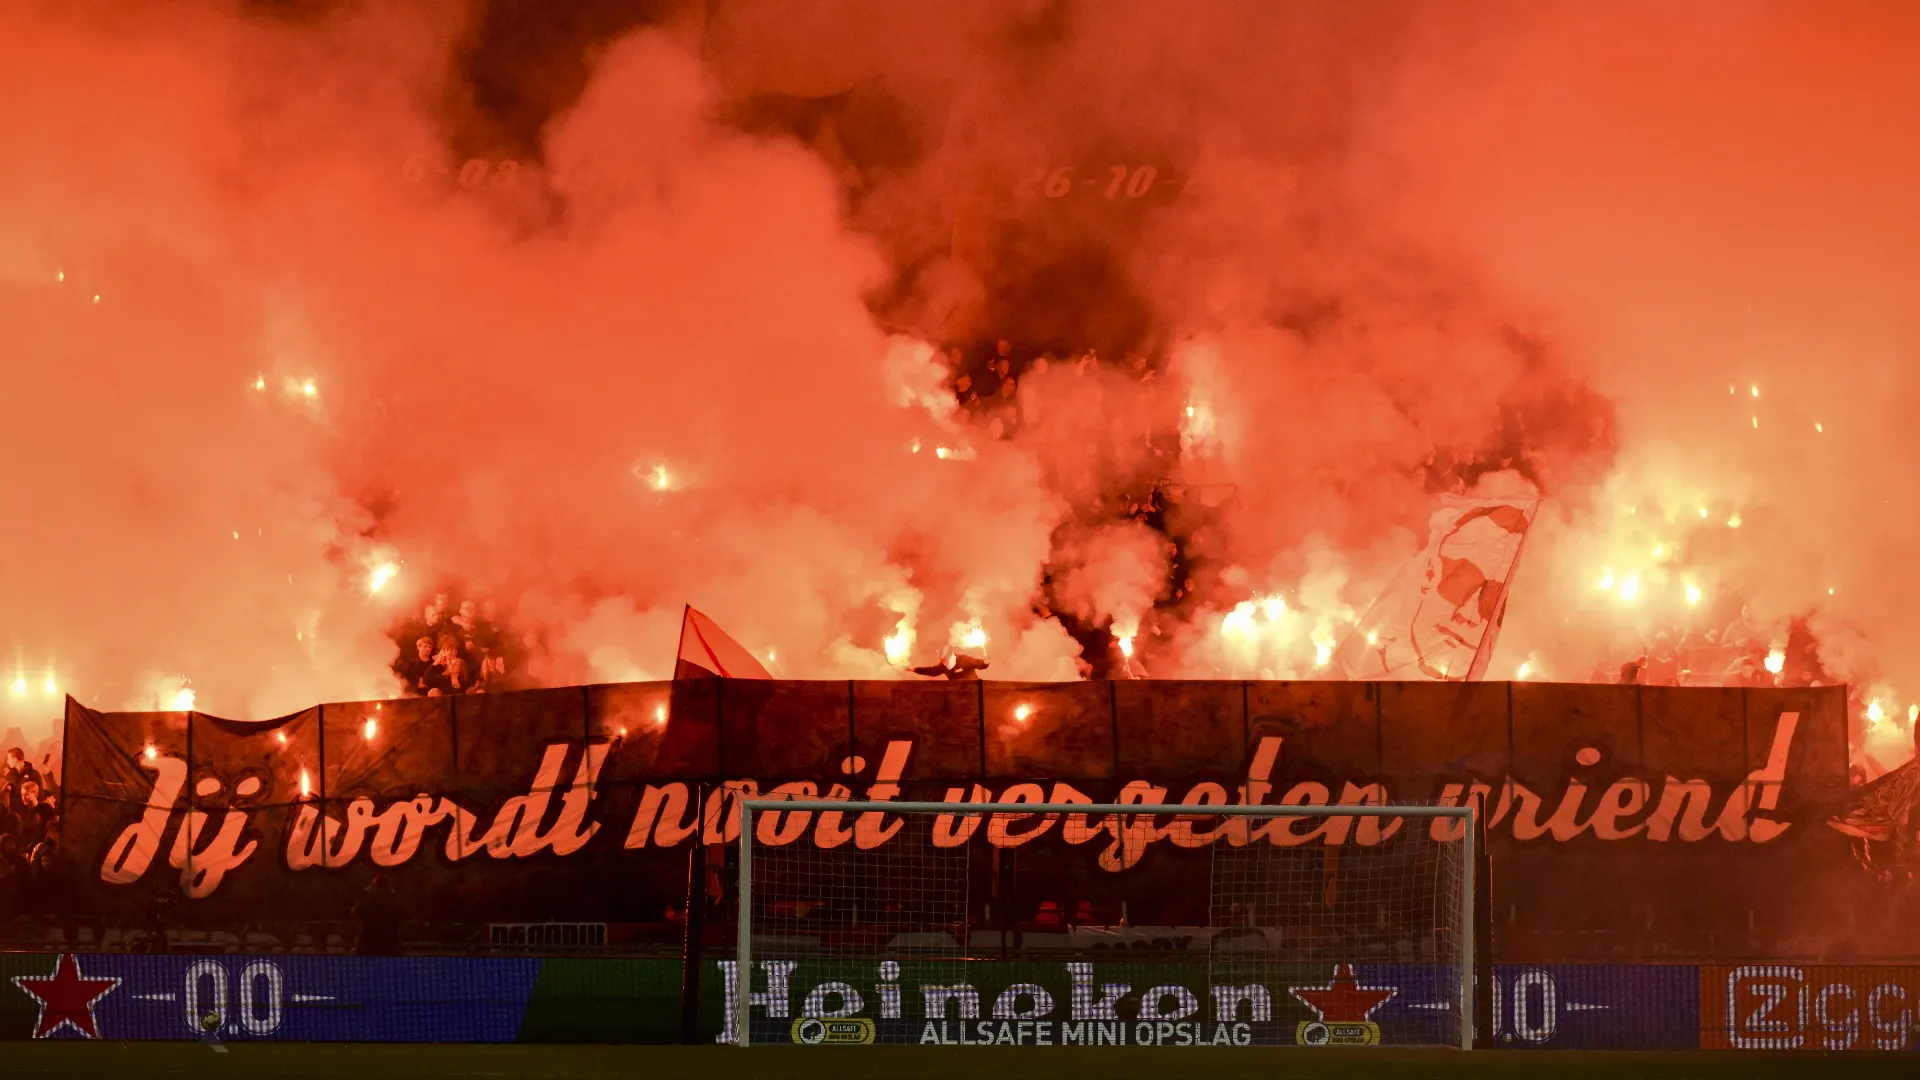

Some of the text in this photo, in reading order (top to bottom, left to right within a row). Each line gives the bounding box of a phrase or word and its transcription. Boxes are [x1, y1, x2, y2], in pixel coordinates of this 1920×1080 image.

[286, 742, 611, 869] wordt
[623, 740, 913, 850] nooit
[931, 736, 1404, 873] vergeten
[1430, 711, 1799, 843] vriend
[185, 960, 283, 1035] 0.0
[919, 1021, 1251, 1046] ALLSAFE MINI OPSLAG
